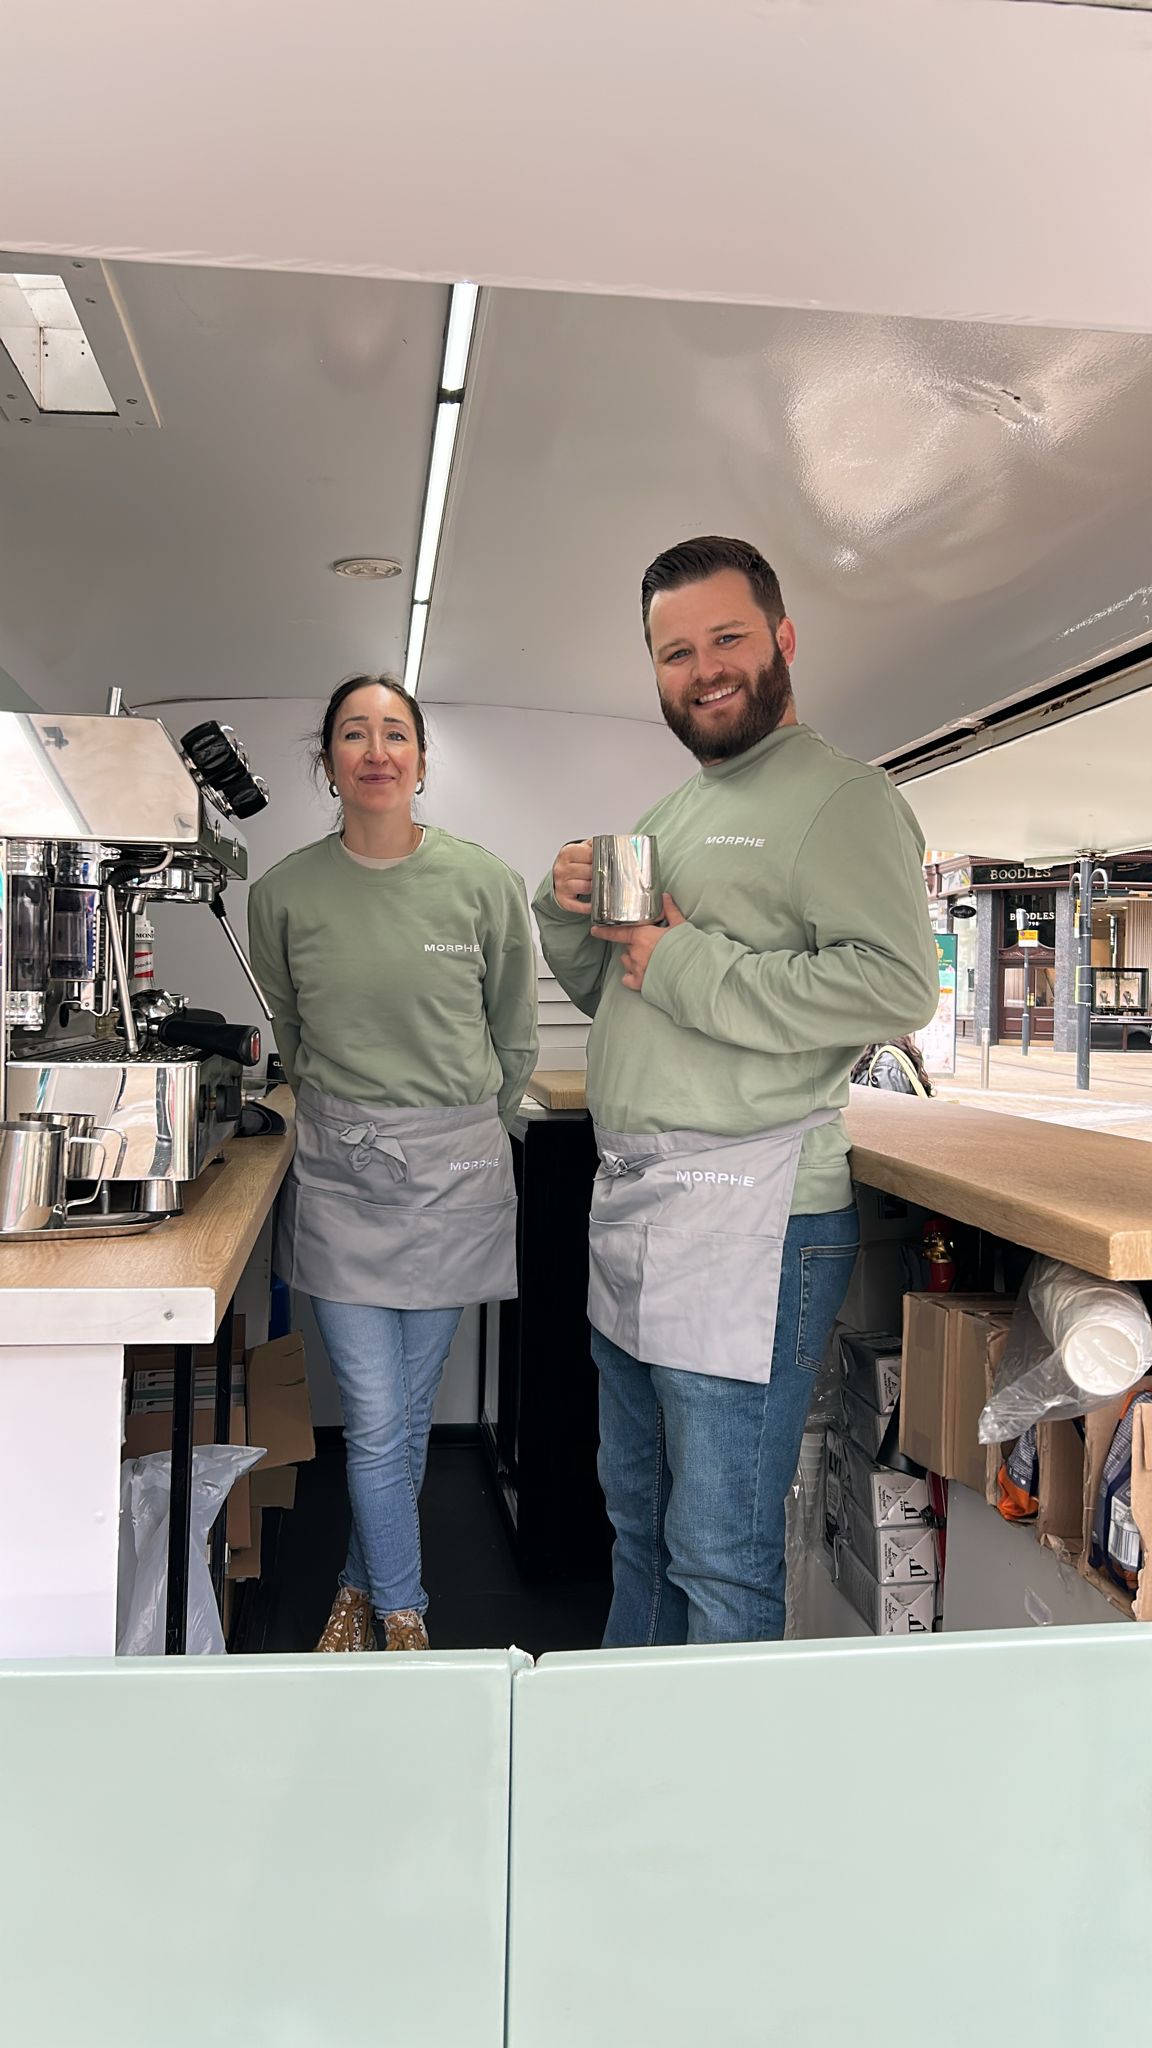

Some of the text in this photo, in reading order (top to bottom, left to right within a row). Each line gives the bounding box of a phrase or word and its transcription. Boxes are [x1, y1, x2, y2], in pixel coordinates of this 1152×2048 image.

[704, 835, 766, 848] MORPHE
[990, 868, 1052, 880] BOODLES
[1009, 911, 1055, 921] BDLES
[423, 943, 481, 953] MORPHE
[450, 1158, 499, 1171] MORPHE
[676, 1170, 756, 1188] MORPHE
